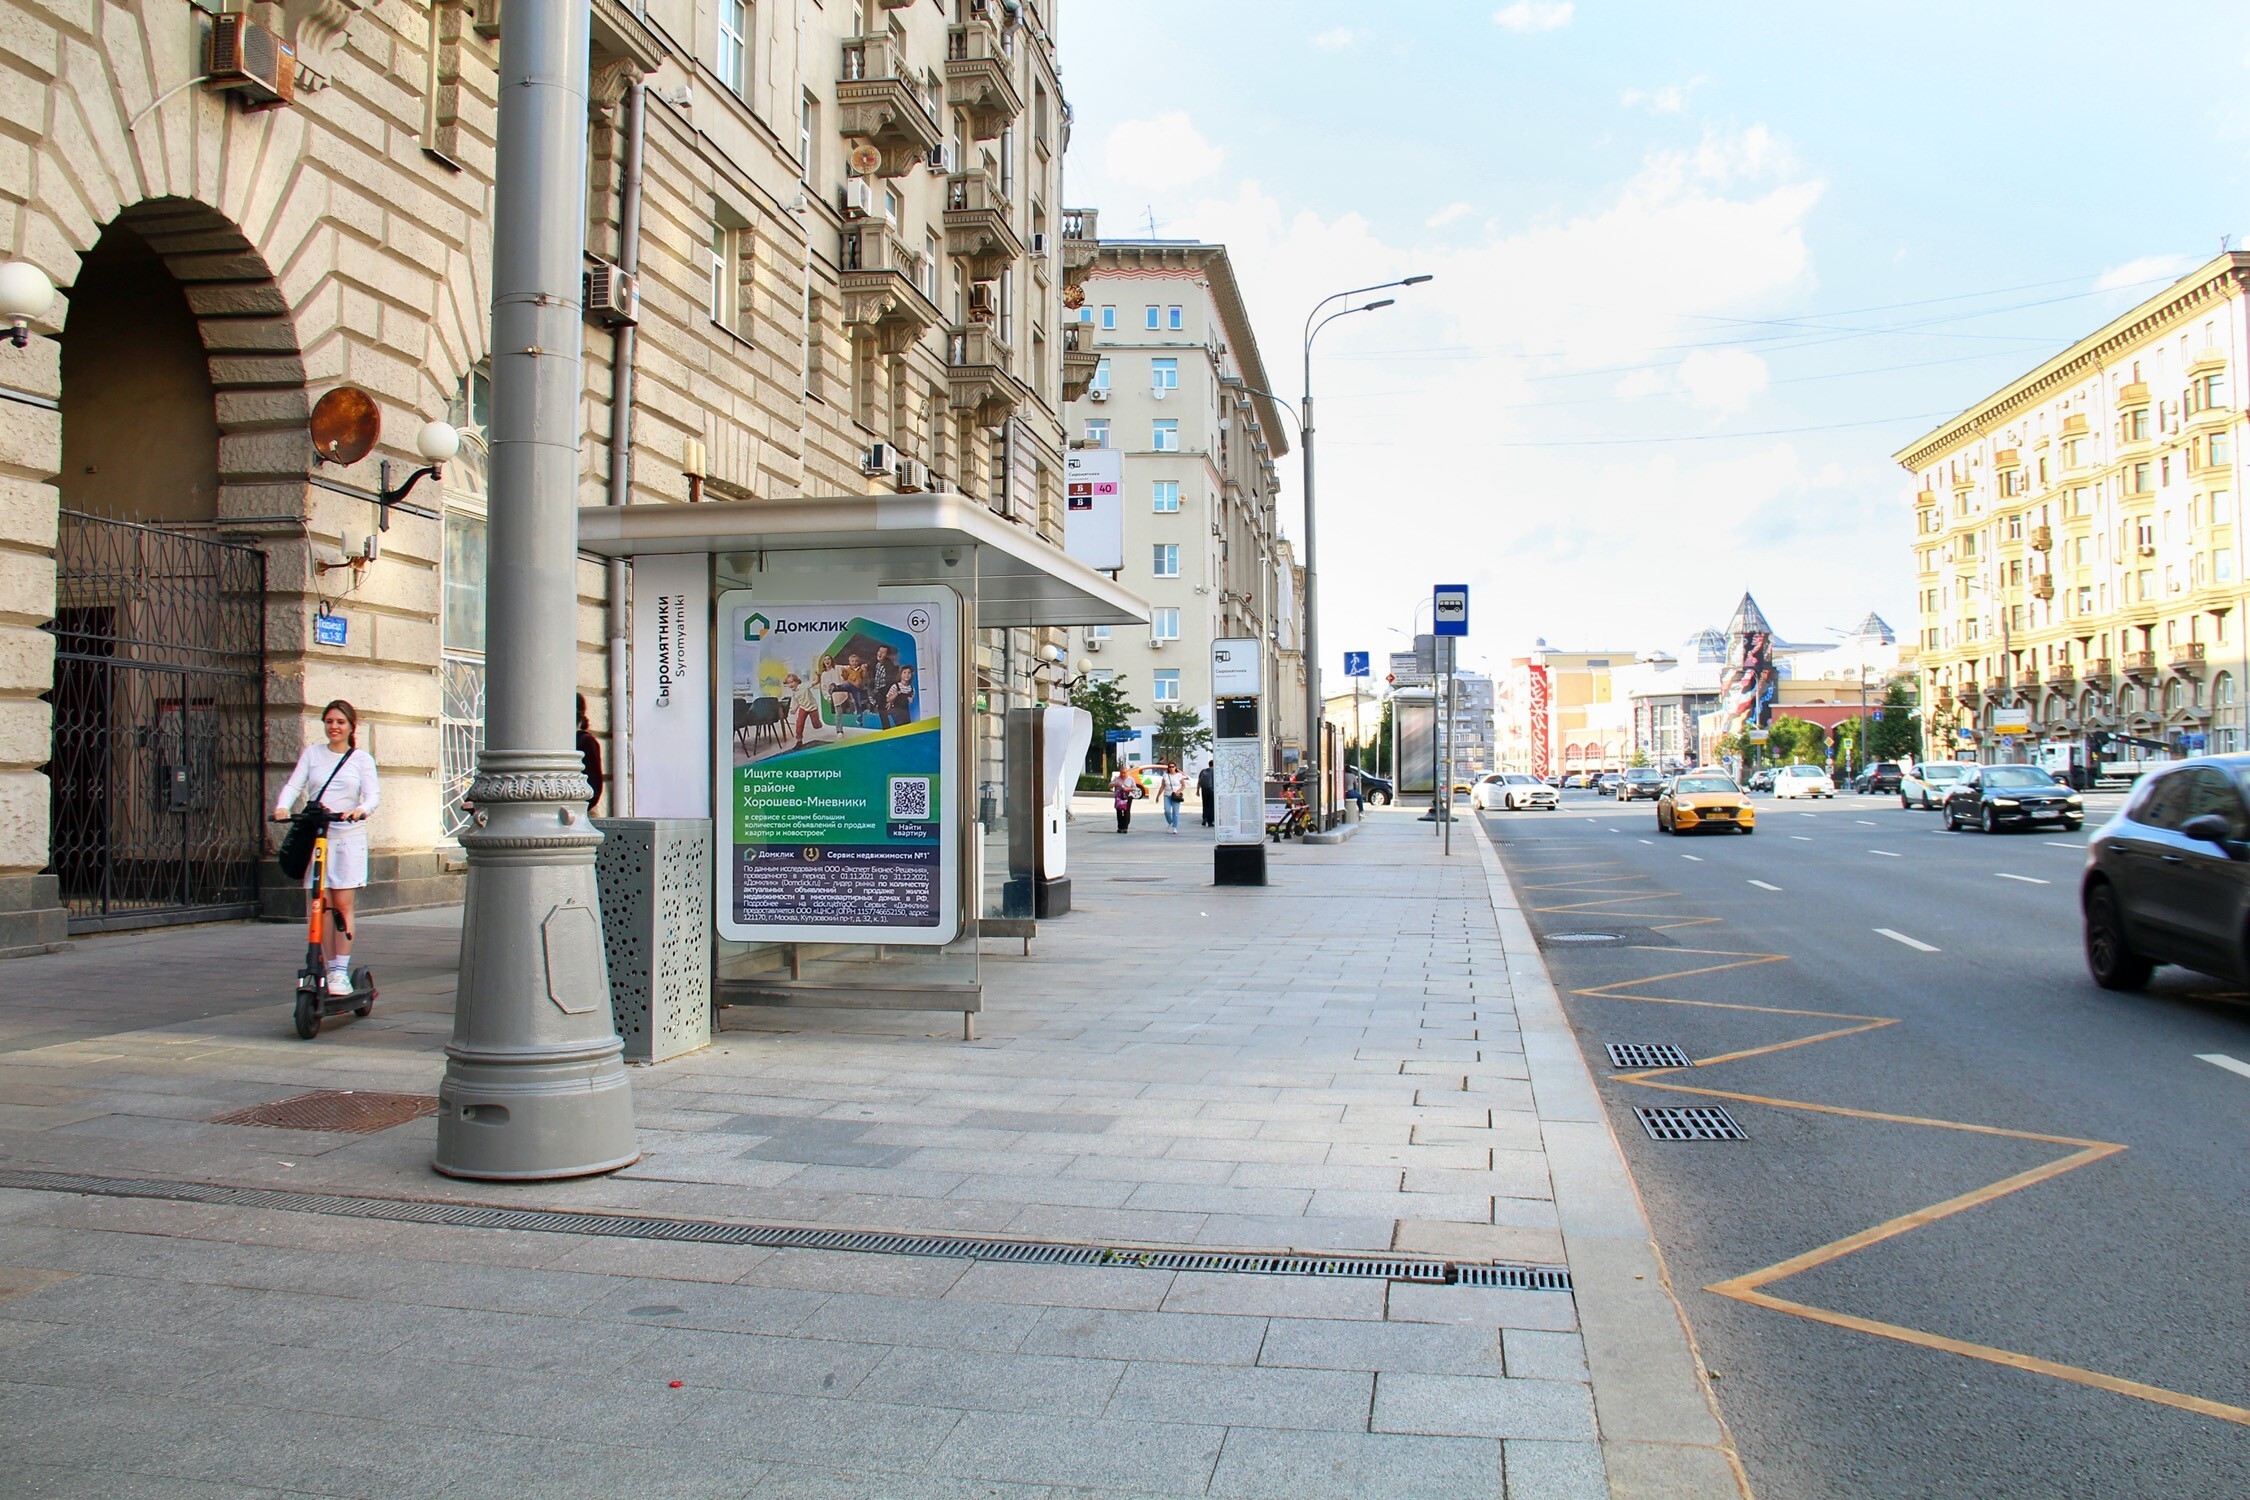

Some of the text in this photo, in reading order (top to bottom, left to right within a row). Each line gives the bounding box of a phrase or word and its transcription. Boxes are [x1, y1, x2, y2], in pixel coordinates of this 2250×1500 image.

[1100, 484, 1112, 493] 40
[775, 620, 848, 634] Домклик
[911, 616, 926, 627] 6+
[675, 594, 687, 677] Syromyatniki
[656, 596, 672, 707] Сыромятники
[744, 768, 841, 780] Ищите квартиры
[754, 782, 795, 794] районе
[744, 796, 867, 808] Хорошево-Мневники
[827, 851, 855, 859] Сервис
